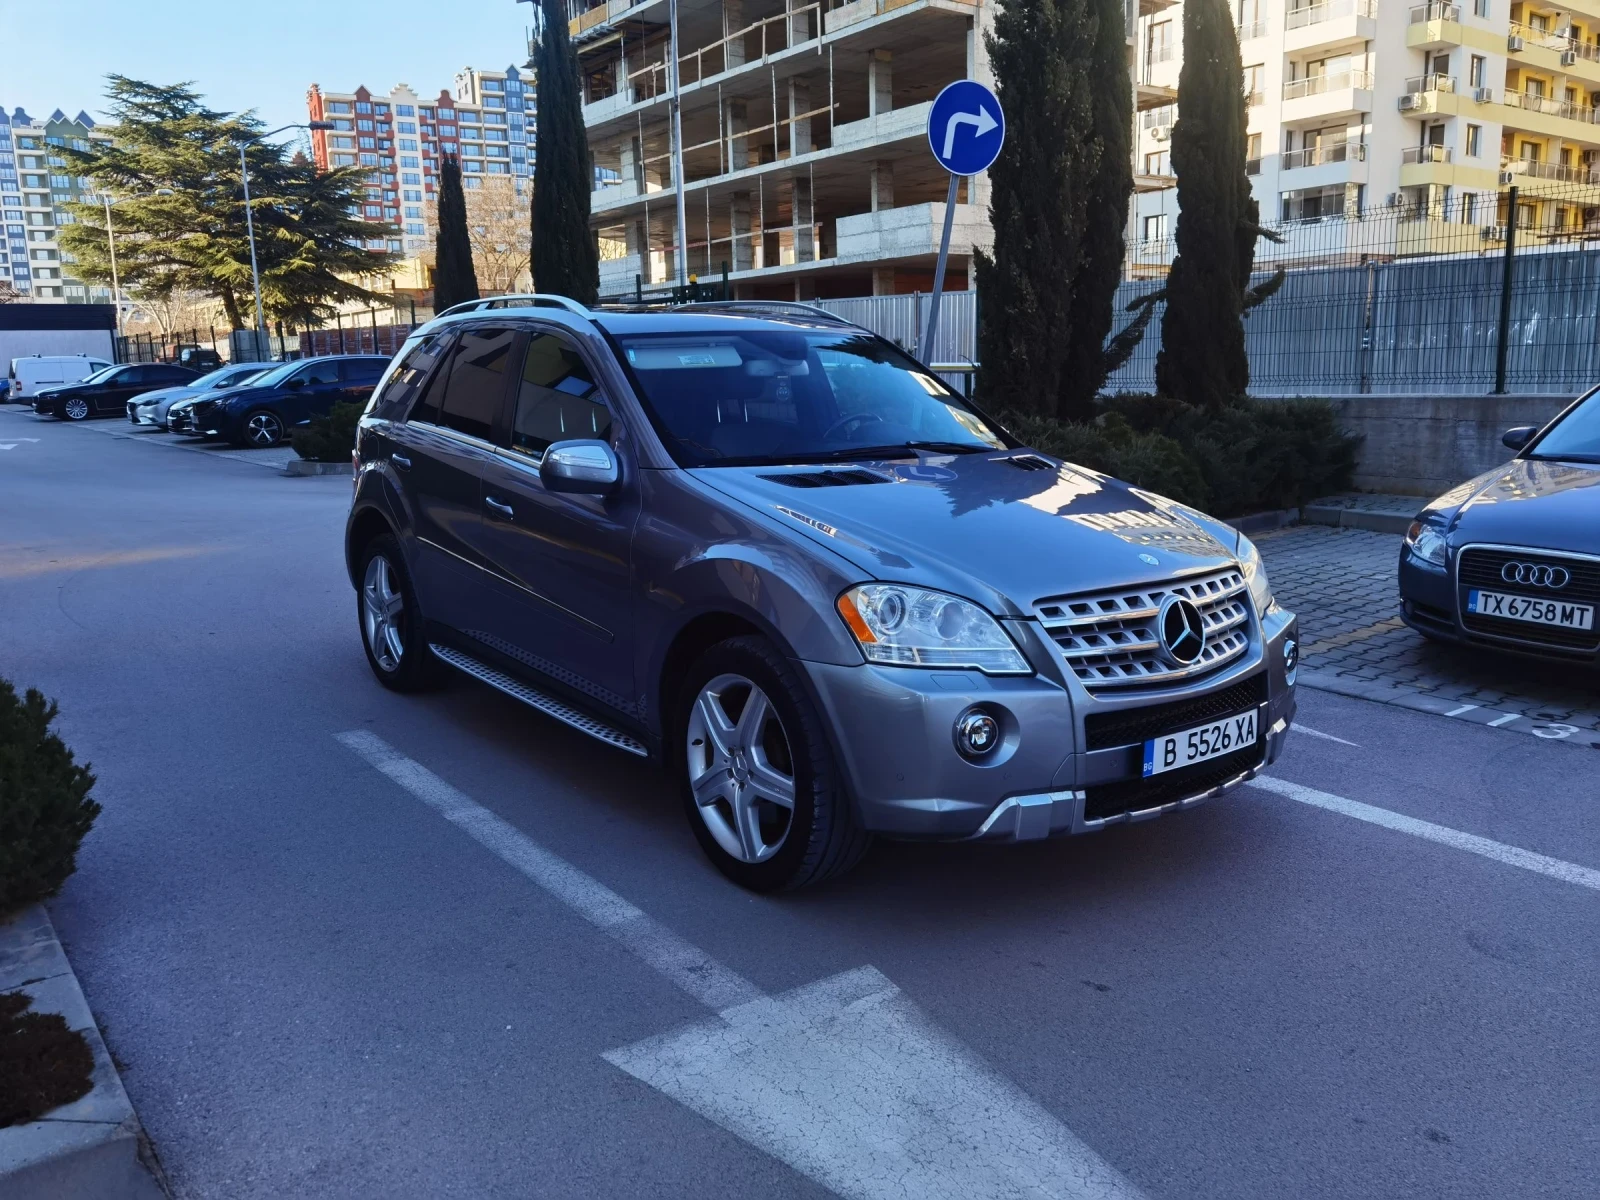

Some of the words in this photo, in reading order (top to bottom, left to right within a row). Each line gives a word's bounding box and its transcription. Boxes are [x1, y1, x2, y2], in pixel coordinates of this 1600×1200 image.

[1481, 593, 1505, 615] TX
[1508, 598, 1557, 622] 6758
[1560, 605, 1590, 627] MT
[1164, 738, 1177, 768] B
[1187, 722, 1232, 761] 5526
[1235, 714, 1255, 746] XA
[1143, 762, 1153, 772] BG
